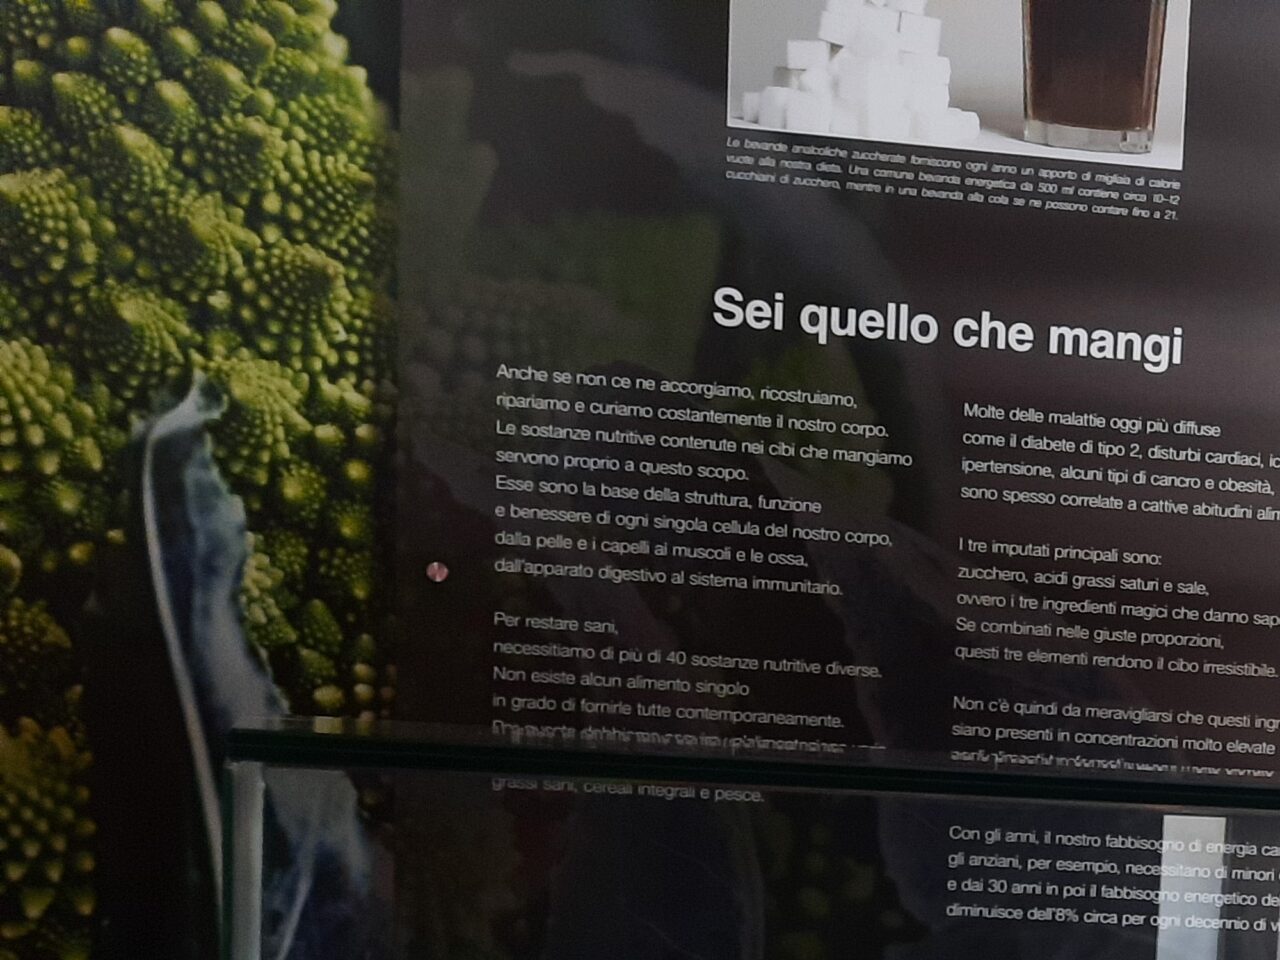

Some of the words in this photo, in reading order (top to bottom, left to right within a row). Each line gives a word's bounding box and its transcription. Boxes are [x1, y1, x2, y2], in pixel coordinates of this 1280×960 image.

[713, 286, 783, 330] Sei
[800, 302, 938, 344] quello
[953, 310, 1033, 351] che
[1049, 326, 1181, 372] mangi
[496, 363, 548, 381] Anche
[552, 371, 572, 384] se
[576, 373, 606, 385] non
[611, 376, 631, 388] ce
[635, 378, 655, 390] ne
[660, 380, 755, 400] accorgiamo,
[760, 385, 858, 408] ricostruiamo,
[496, 391, 570, 411] ripariamo
[574, 401, 585, 412] e
[589, 401, 653, 417] curiamo
[657, 407, 771, 427] costantemente
[776, 413, 783, 428] il
[788, 418, 836, 432] nostro
[840, 422, 889, 438] corpo.
[963, 402, 1004, 419] Molte
[1008, 406, 1044, 422] delle
[1048, 411, 1105, 427] malattie
[1109, 416, 1142, 433] oggi
[1146, 418, 1168, 434] più
[1172, 419, 1220, 437] diffuse
[495, 450, 559, 465] servono
[563, 455, 620, 471] proprio
[624, 460, 634, 471] a
[638, 461, 692, 476] questo
[696, 465, 750, 481] scopo.
[962, 432, 1005, 446] come
[1009, 433, 1016, 447] il
[1020, 435, 1075, 452] diabete
[1079, 439, 1093, 453] di
[1097, 441, 1125, 457] tipo
[1129, 443, 1143, 459] 2,
[1147, 444, 1201, 461] disturbi
[1204, 451, 1264, 468] cardiaci,
[960, 486, 998, 500] sono
[1002, 489, 1055, 504] spesso
[1059, 494, 1123, 509] correlate
[1127, 499, 1136, 510] a
[1141, 499, 1188, 514] cattive
[1192, 501, 1252, 518] abitudini
[958, 537, 963, 550] I
[967, 538, 987, 552] tre
[991, 539, 1050, 557] imputati
[1054, 545, 1118, 563] principali
[1122, 551, 1161, 565] sono:
[494, 557, 593, 577] dall'apparato
[598, 565, 666, 583] digestivo
[670, 570, 684, 584] al
[688, 571, 747, 588] sistema
[752, 575, 843, 595] immunitario.
[957, 566, 1029, 583] zucchero,
[1033, 570, 1068, 584] acidi
[1071, 574, 1115, 589] grassi
[1119, 577, 1158, 590] saturi
[1163, 581, 1172, 592] e
[1176, 580, 1210, 595] sale,
[492, 642, 595, 659] necessitiamo
[599, 646, 614, 660] di
[618, 648, 642, 663] più
[647, 649, 661, 663] di
[666, 650, 686, 665] 40
[690, 654, 758, 669] sostanze
[762, 658, 821, 673] nutritive
[825, 661, 882, 677] diverse.
[492, 665, 526, 680] Non
[530, 671, 575, 684] esiste
[579, 671, 621, 687] alcun
[626, 674, 690, 692] alimento
[695, 679, 749, 697] singolo
[951, 724, 991, 737] siano
[994, 727, 1053, 740] presenti
[1057, 731, 1070, 741] in
[1074, 732, 1178, 748] concentrazioni
[1182, 737, 1222, 751] molto
[1226, 739, 1275, 754] elevate
[948, 825, 980, 840] Con
[984, 828, 1001, 844] gli
[1004, 830, 1040, 844] anni,
[1043, 830, 1051, 843] il
[1055, 833, 1101, 847] nostro
[1105, 834, 1183, 853] fabbisogno
[1188, 838, 1200, 852] di
[1206, 839, 1257, 857] energia
